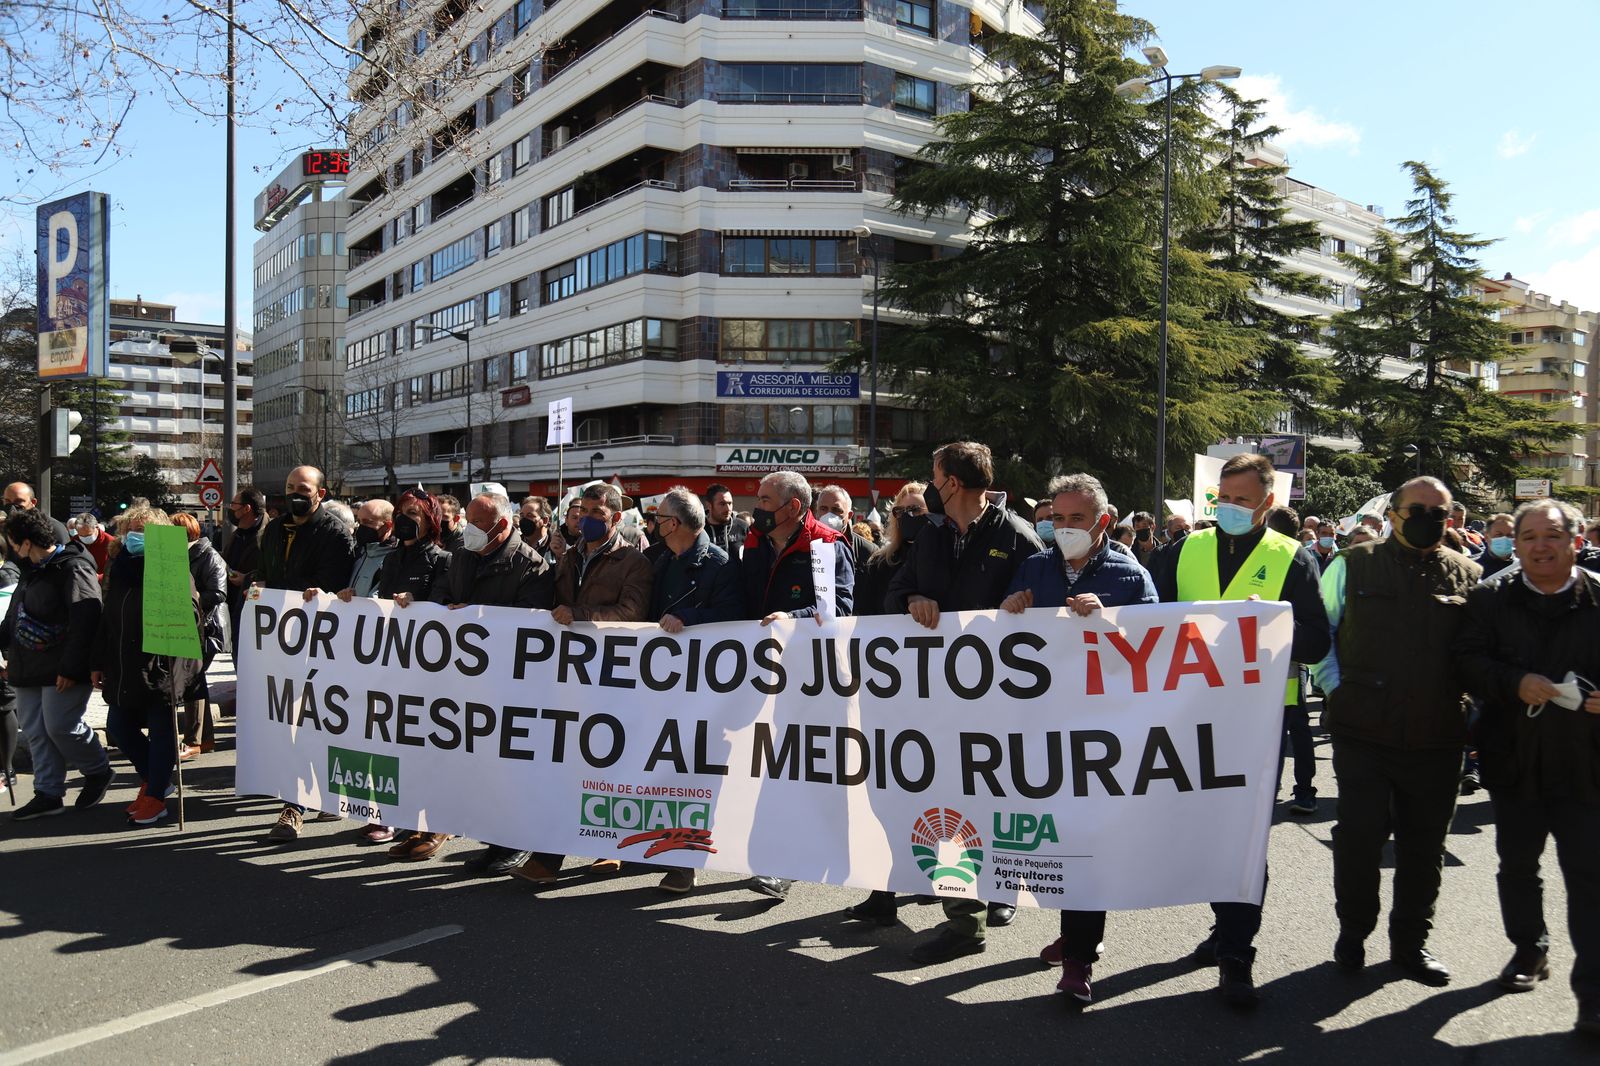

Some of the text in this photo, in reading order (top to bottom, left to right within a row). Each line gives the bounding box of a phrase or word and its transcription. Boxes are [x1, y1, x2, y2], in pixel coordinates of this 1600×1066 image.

[48, 210, 79, 319] P
[50, 348, 75, 365] empark
[749, 372, 852, 385] ASESORÍA MIELGO
[749, 386, 851, 396] CORREDURÍA DE SEGUROS
[726, 448, 820, 464] ADINCO
[205, 492, 218, 500] 20
[254, 604, 340, 660] POR
[353, 614, 490, 677] UNOS
[513, 627, 788, 695] PRECIOS
[800, 632, 1052, 699] JUSTOS
[267, 668, 1246, 799] MÁS RESPETO AL MEDIO RURAL
[582, 780, 712, 799] UNIÓN DE CAMPESINOS
[340, 801, 382, 820] ZAMORA
[583, 796, 706, 831] COAG
[579, 828, 618, 840] ZAMORA
[992, 811, 1059, 851] UPA
[992, 855, 1063, 871] Unión de Pequeños
[994, 867, 1064, 882] Agricultores
[938, 884, 966, 893] Zamora
[995, 880, 1065, 895] y Ganaderos
